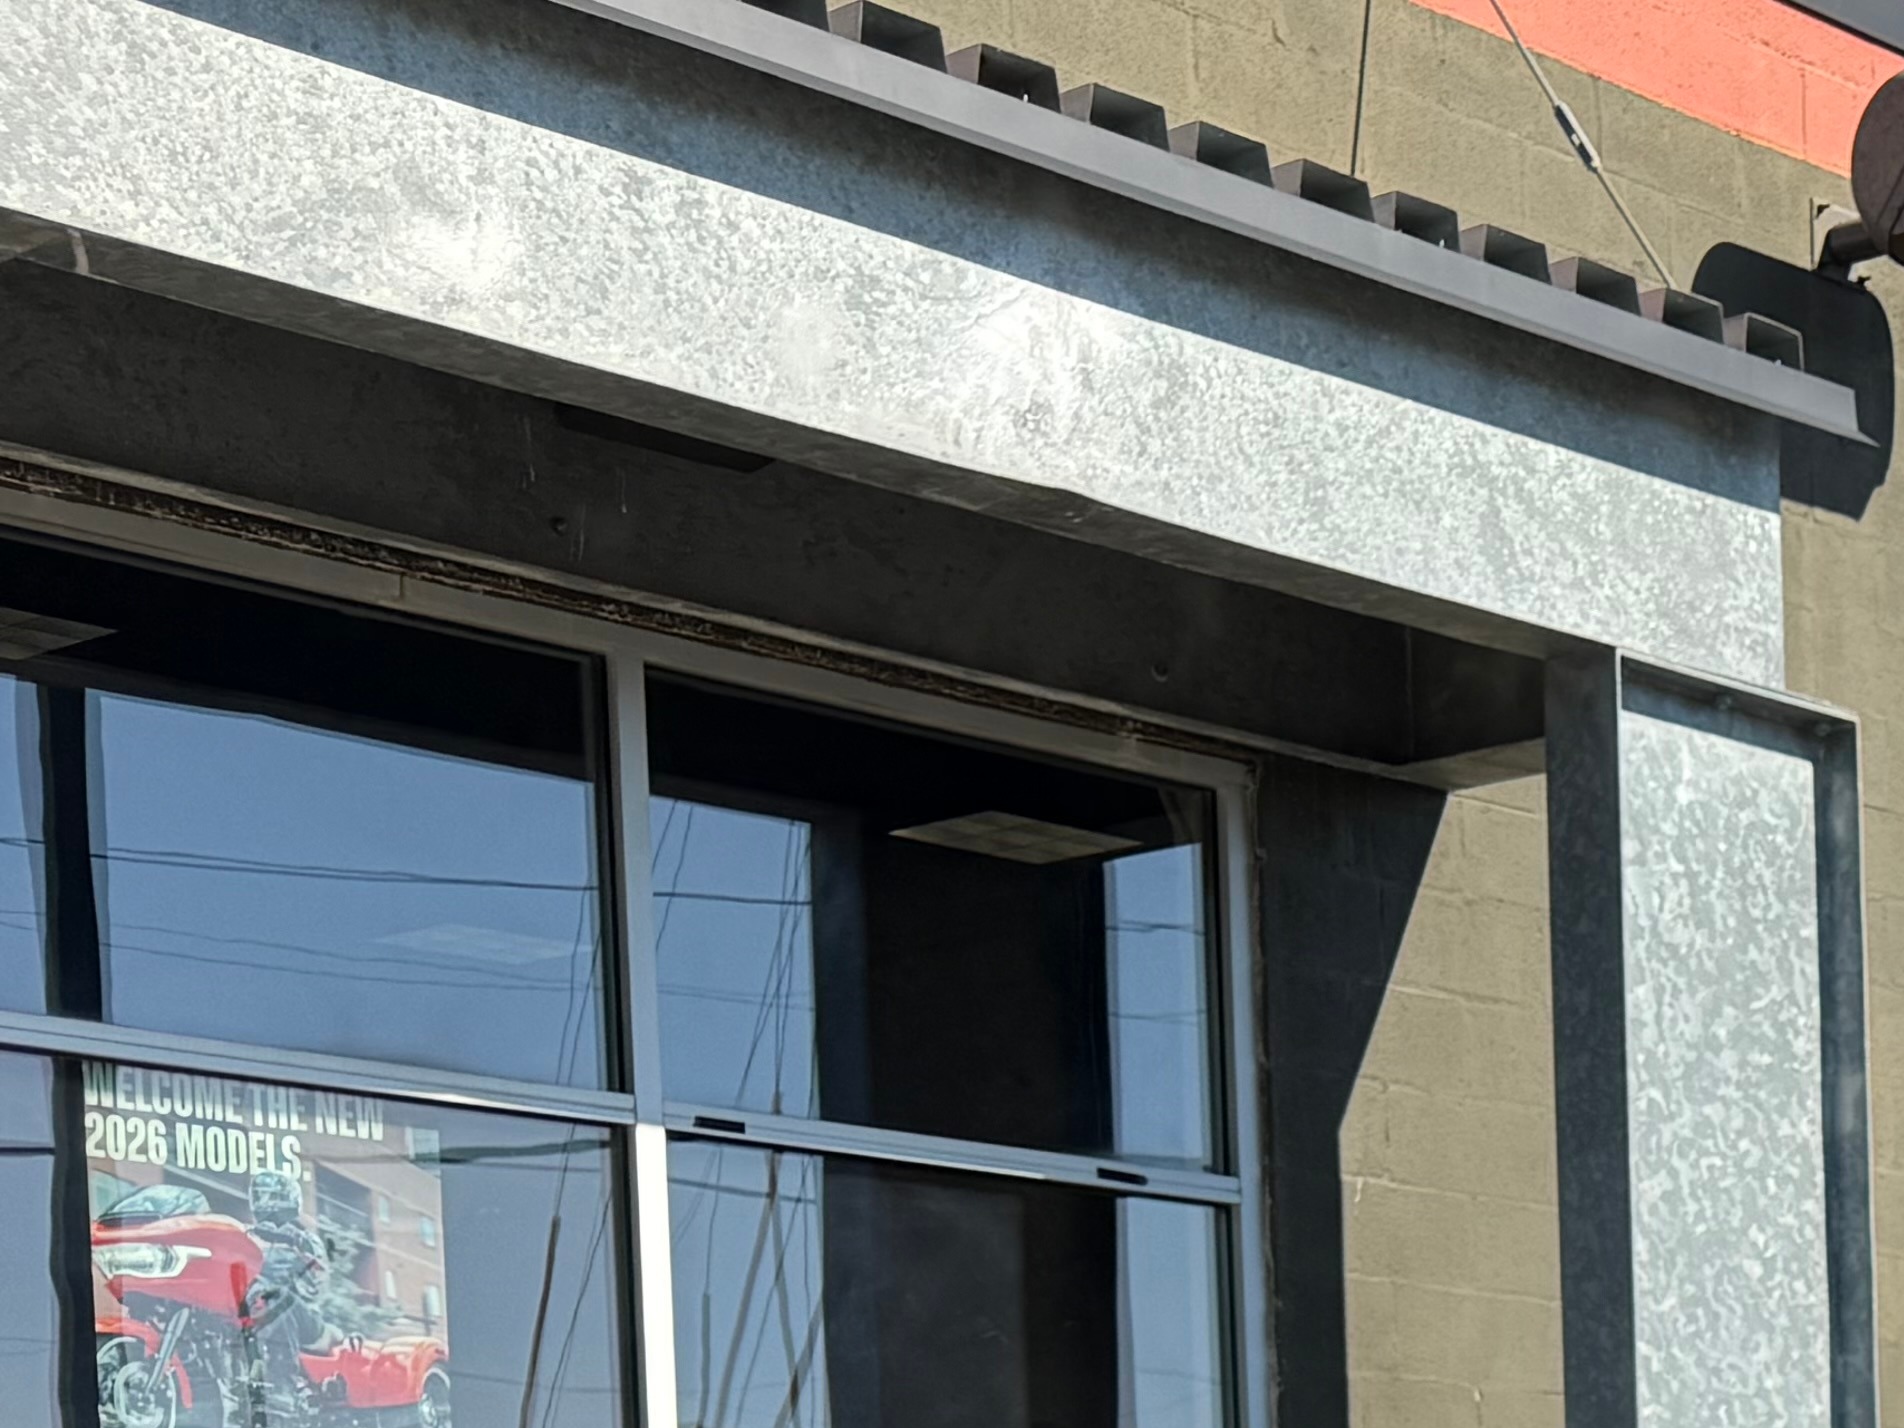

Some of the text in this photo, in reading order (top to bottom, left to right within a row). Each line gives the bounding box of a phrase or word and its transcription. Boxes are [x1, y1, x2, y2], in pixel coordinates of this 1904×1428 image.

[82, 1061, 385, 1141] WELCOME THE NEW
[86, 1112, 312, 1182] 2026 MODELS.
